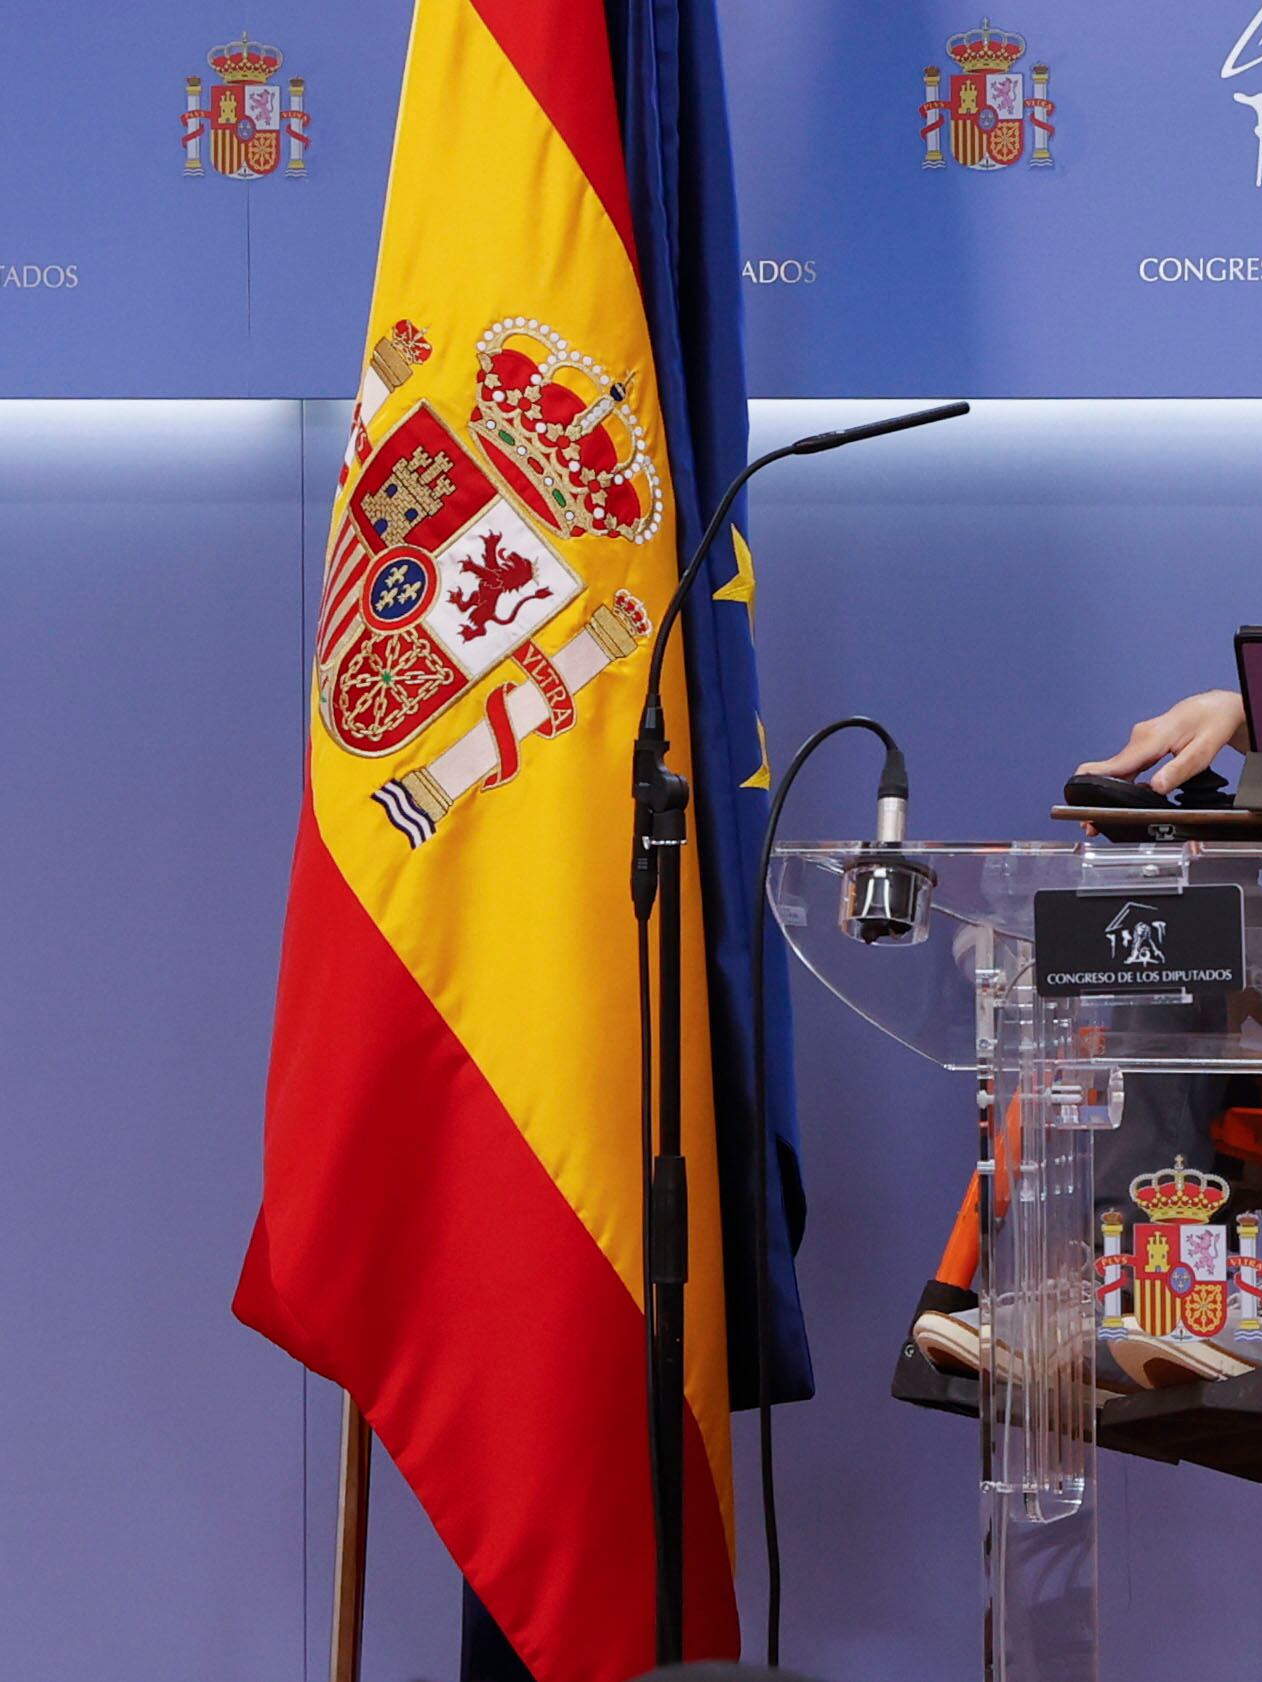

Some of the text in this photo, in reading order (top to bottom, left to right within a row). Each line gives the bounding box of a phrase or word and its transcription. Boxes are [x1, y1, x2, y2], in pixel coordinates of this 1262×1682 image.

[1046, 969, 1233, 985] CONGRESO DE LOS DIPUTADOS
